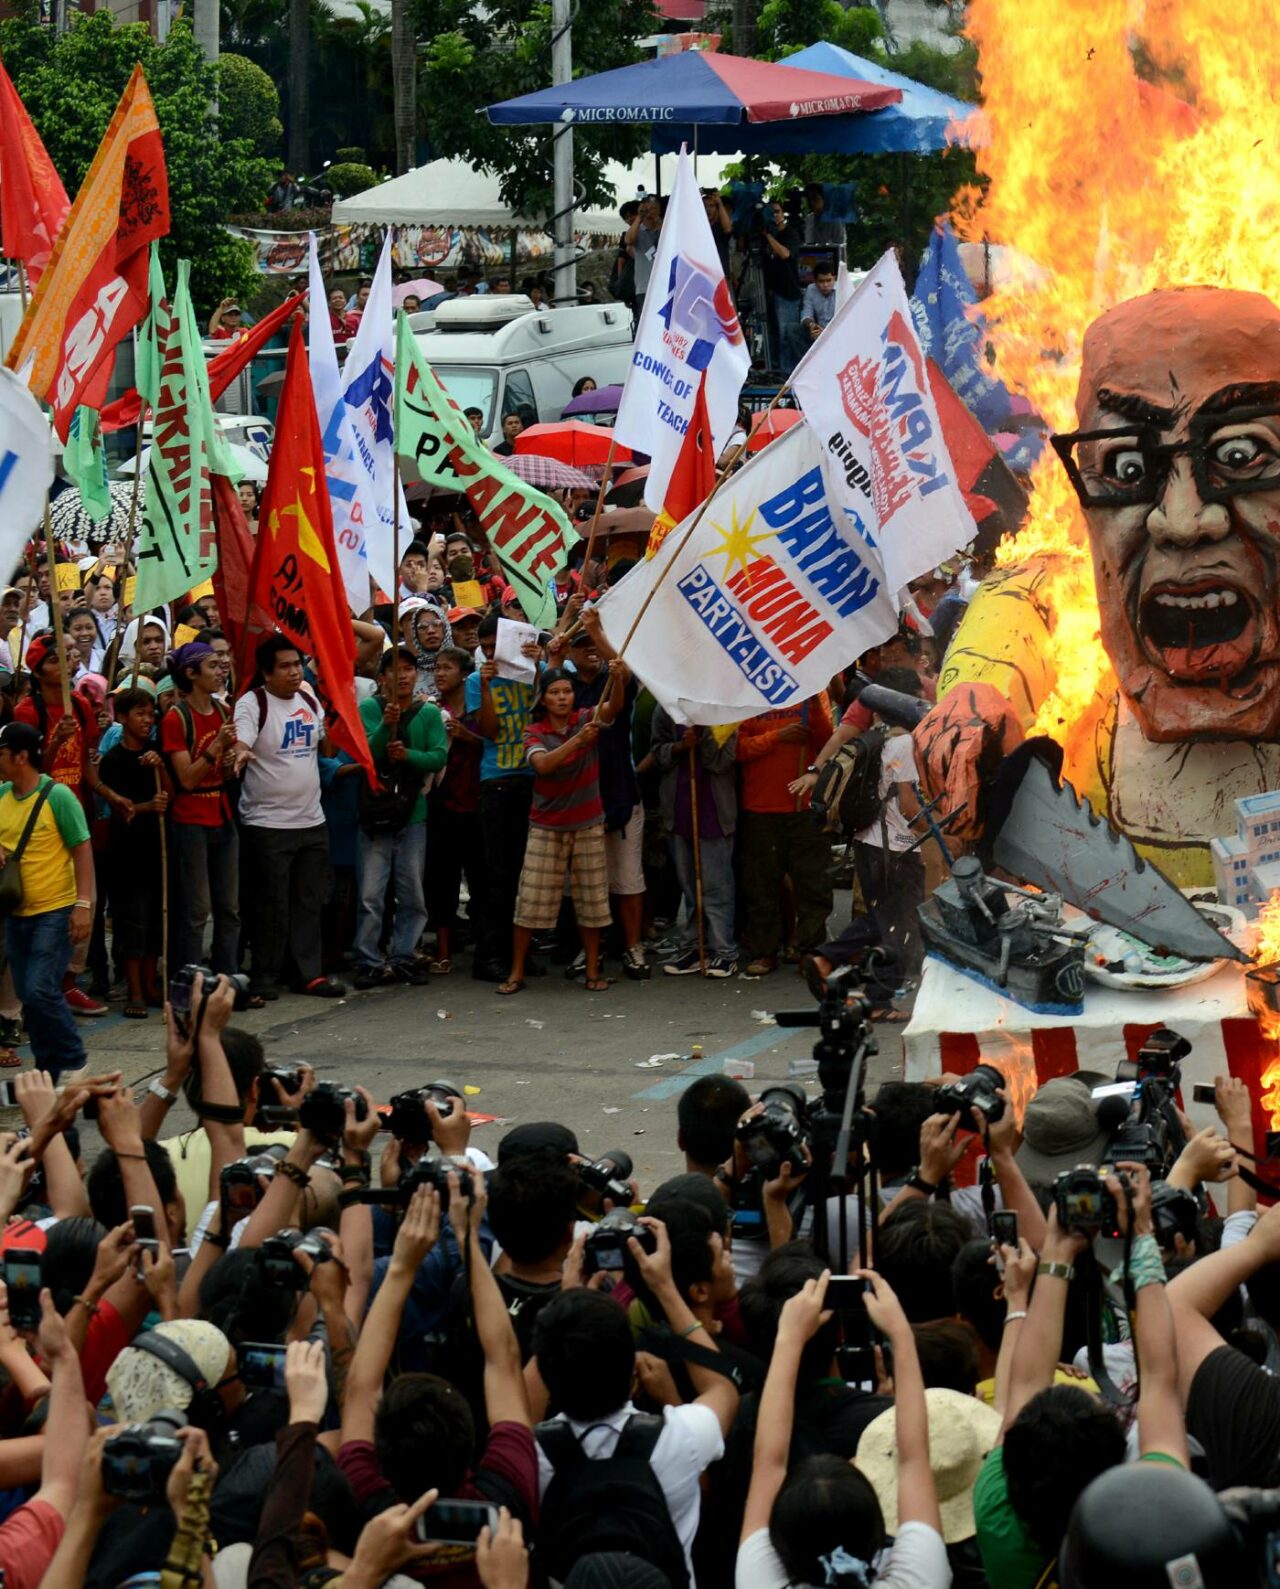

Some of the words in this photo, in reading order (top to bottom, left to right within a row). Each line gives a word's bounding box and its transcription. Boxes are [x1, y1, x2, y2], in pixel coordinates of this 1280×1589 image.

[579, 107, 674, 121] MICROMATIC
[799, 95, 861, 115] MICROMATIC
[674, 380, 693, 400] OF
[758, 465, 880, 618] BAYAN
[681, 568, 798, 701] PARTY-LIST
[726, 555, 834, 666] MUNA
